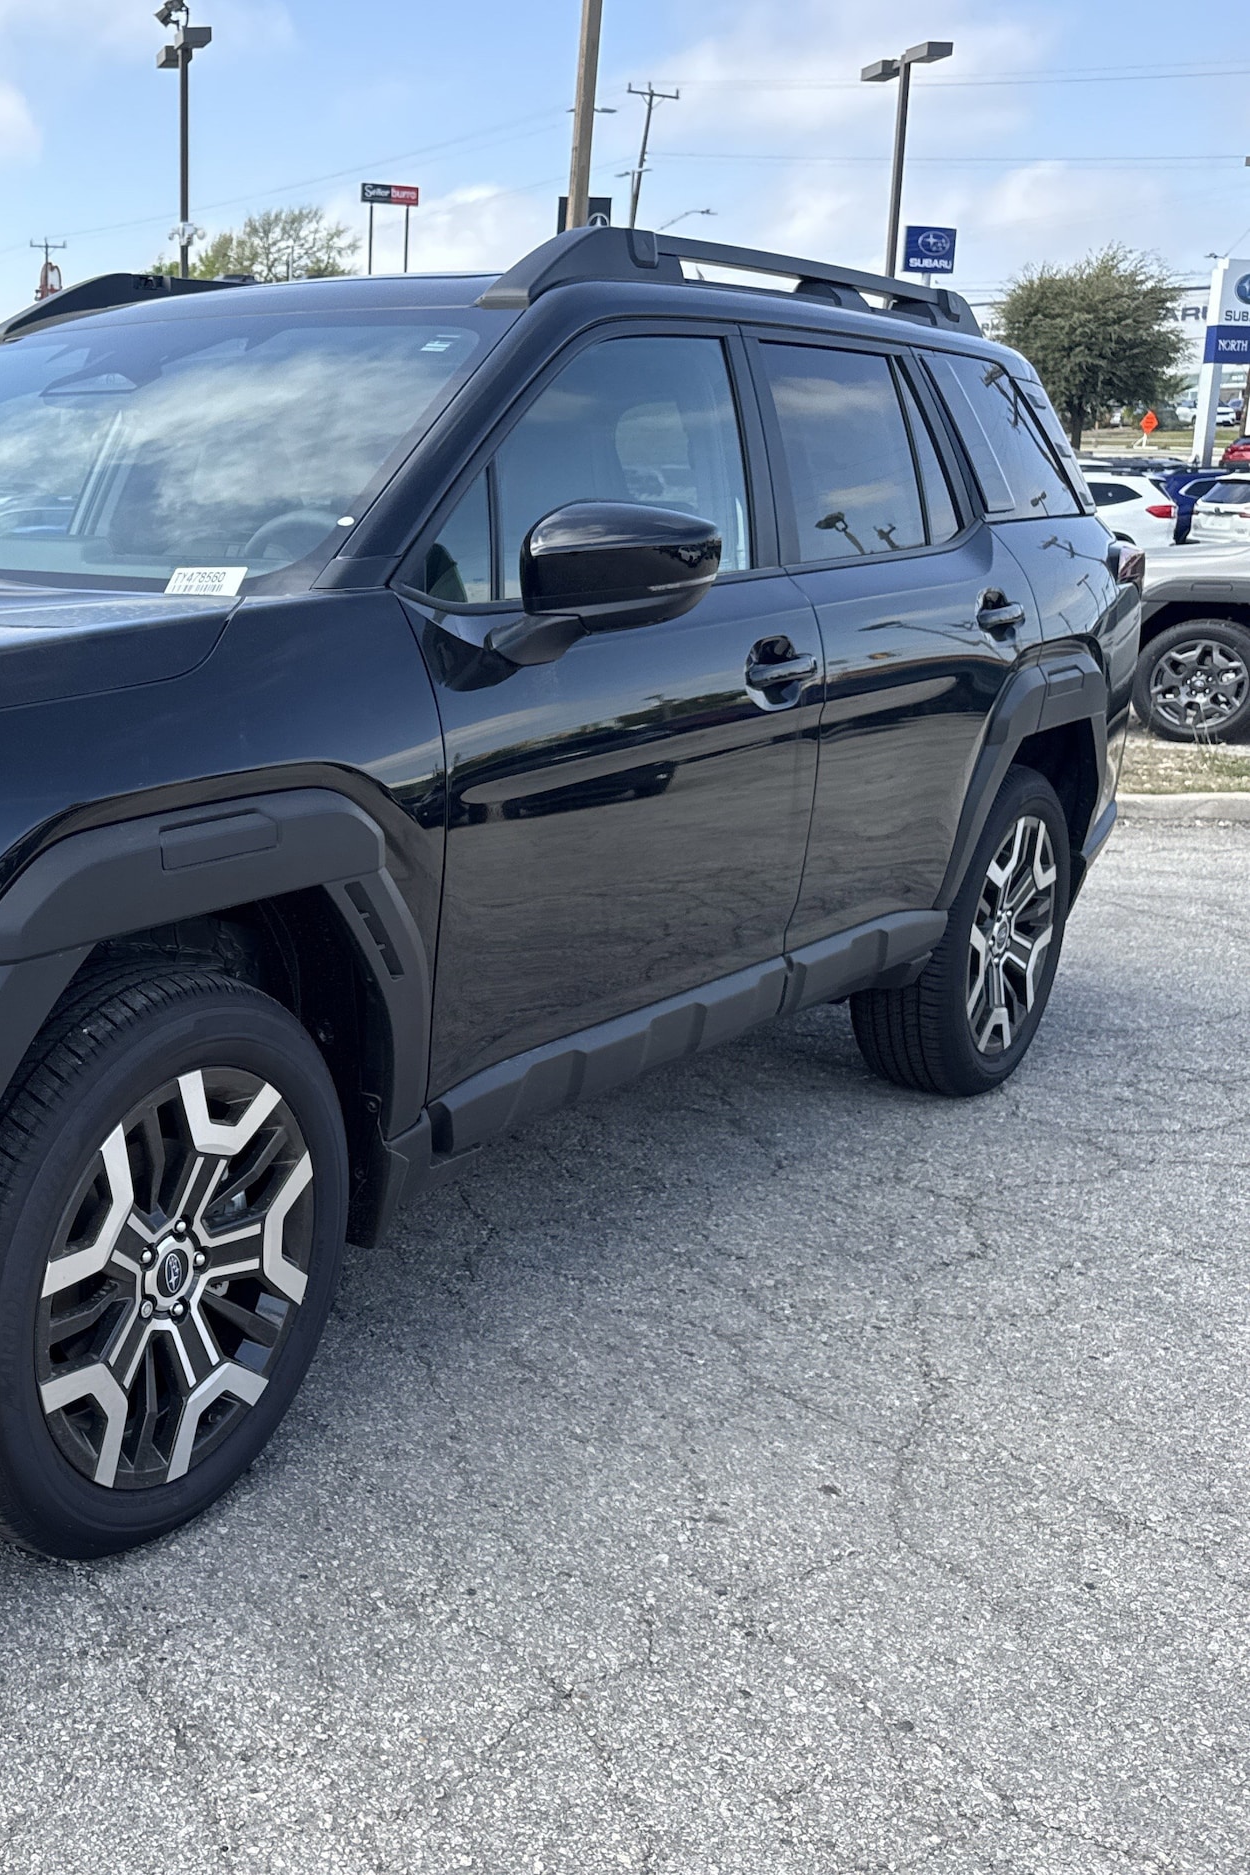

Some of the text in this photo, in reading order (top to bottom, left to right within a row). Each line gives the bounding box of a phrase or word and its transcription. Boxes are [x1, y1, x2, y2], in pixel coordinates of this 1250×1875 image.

[908, 257, 952, 270] SUBARU
[1224, 310, 1250, 322] SUB
[1217, 339, 1249, 352] NORTH
[174, 571, 227, 584] TY478560
